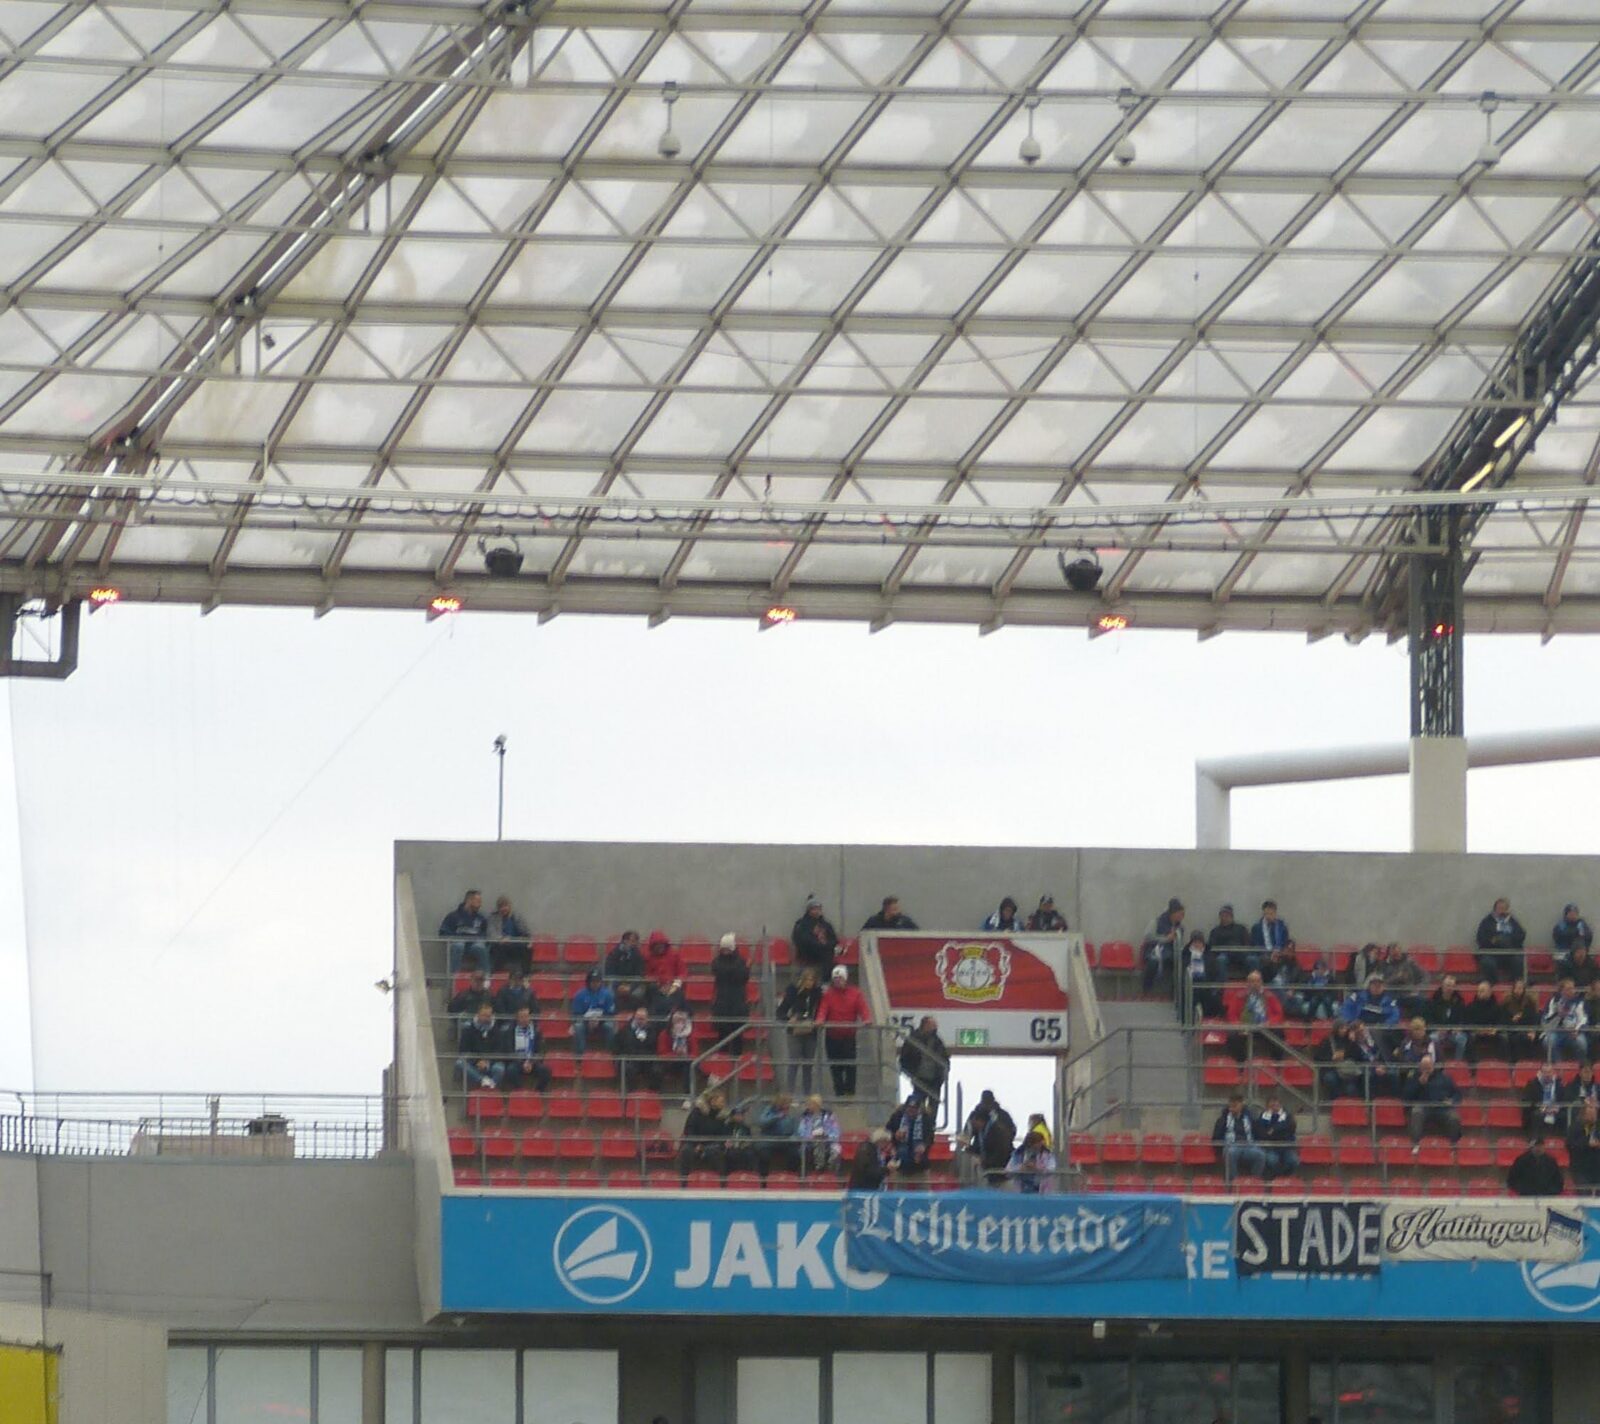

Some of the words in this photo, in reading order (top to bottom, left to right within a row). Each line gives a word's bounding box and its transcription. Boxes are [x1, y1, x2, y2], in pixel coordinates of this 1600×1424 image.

[1030, 1018, 1061, 1042] G5
[856, 1194, 1131, 1255] Lichtenrade
[1241, 1206, 1380, 1265] STADE
[1386, 1205, 1543, 1254] Hattingen
